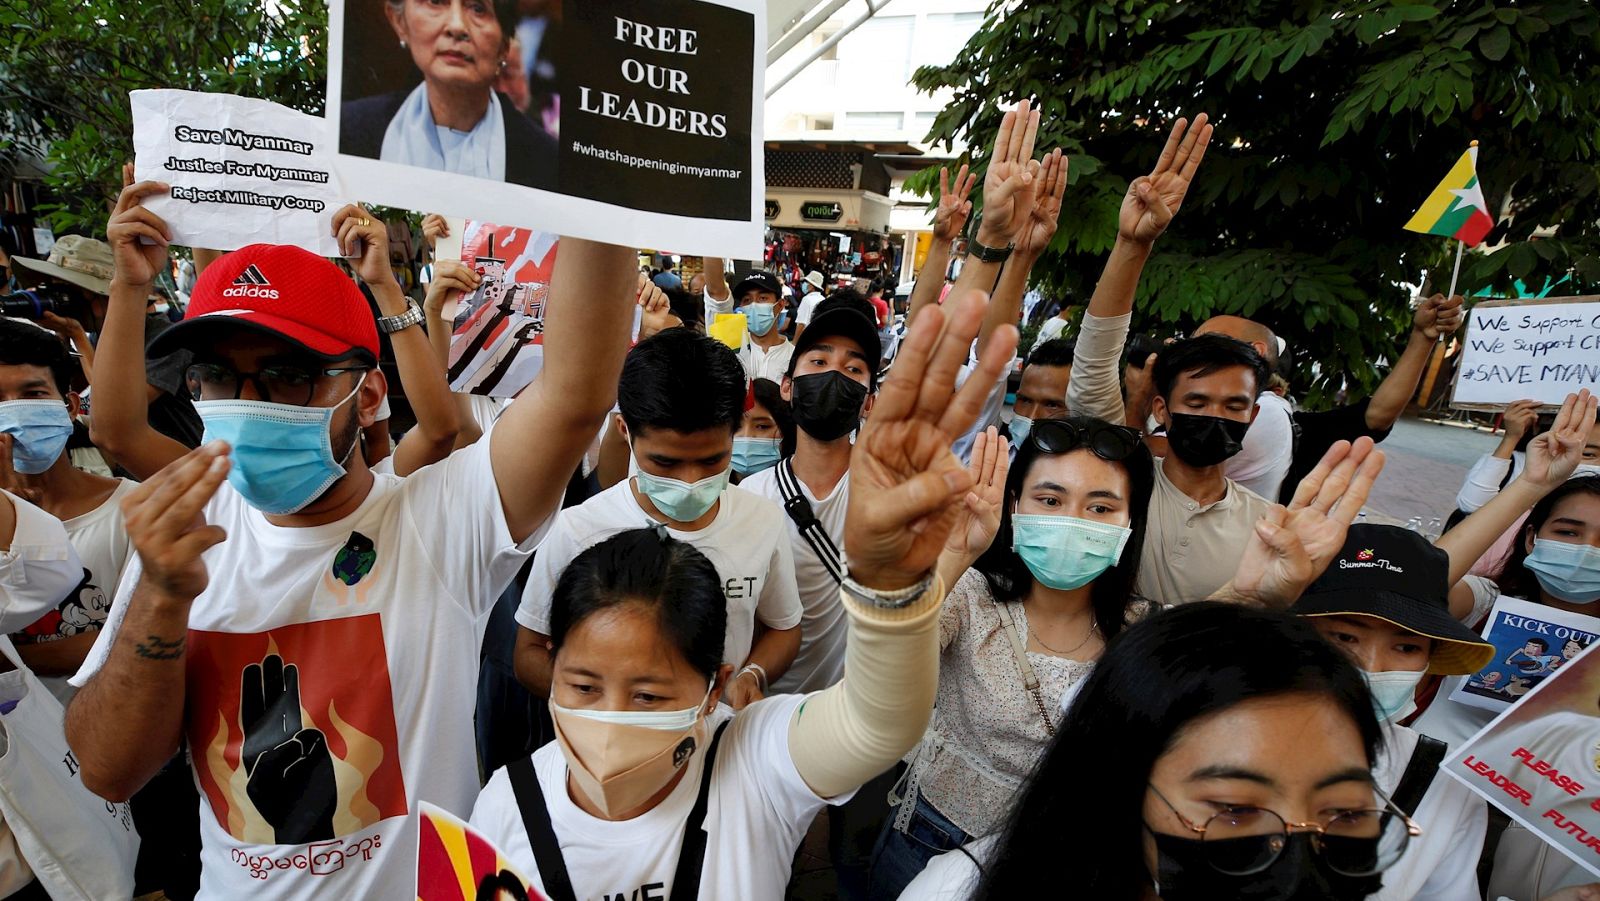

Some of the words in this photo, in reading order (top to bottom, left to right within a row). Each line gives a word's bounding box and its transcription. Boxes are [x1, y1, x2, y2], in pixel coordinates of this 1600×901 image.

[614, 16, 698, 55] FREE
[621, 58, 690, 95] OUR
[578, 86, 727, 138] LEADERS
[175, 125, 223, 145] Save
[223, 128, 313, 155] Myanmar
[225, 161, 253, 177] For
[255, 164, 329, 183] Myanmar
[572, 141, 742, 179] #whatshappeninginmyanmar
[171, 187, 222, 203] Reject
[283, 196, 325, 212] Coup
[223, 285, 280, 300] adidas
[1477, 315, 1510, 331] We
[1518, 314, 1584, 334] Support
[1471, 338, 1505, 353] We
[1513, 335, 1575, 357] Support
[1462, 364, 1532, 384] #SAVE
[1540, 364, 1600, 384] MYAN
[1503, 614, 1550, 635] KICK
[1554, 627, 1596, 645] OUT
[1511, 747, 1584, 796] PLEASE
